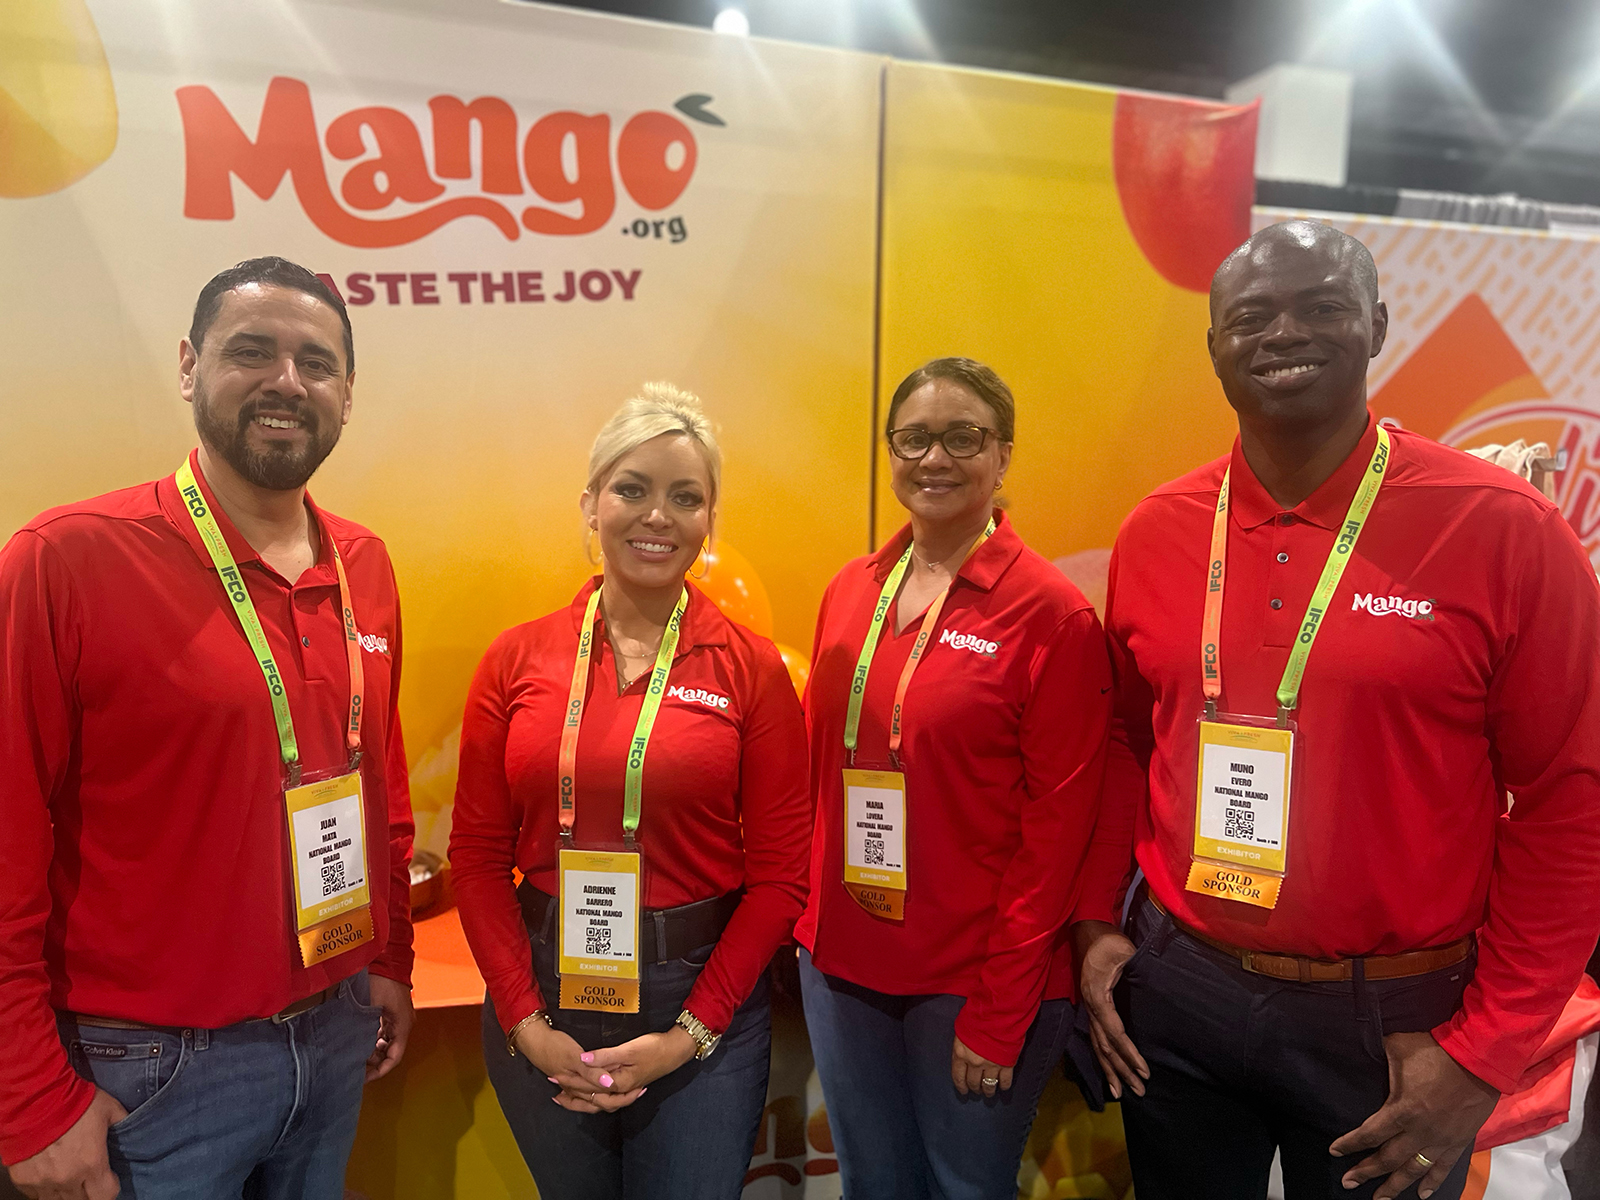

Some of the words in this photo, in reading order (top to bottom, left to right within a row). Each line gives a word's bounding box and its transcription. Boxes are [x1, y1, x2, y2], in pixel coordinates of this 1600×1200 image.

[175, 76, 697, 249] Mango
[621, 216, 687, 243] .org
[315, 272, 440, 307] STE
[448, 271, 543, 305] THE
[554, 270, 643, 304] JOY
[1372, 442, 1388, 474] IFCO
[183, 485, 206, 518] IFCO
[1336, 520, 1360, 554] IFCO
[221, 566, 246, 603] IFCO
[1210, 560, 1222, 592] IFCO
[874, 596, 890, 622] IFCO
[1351, 592, 1432, 618] Mango
[344, 607, 357, 642] IFCO
[1300, 607, 1320, 644] IFCO
[580, 631, 590, 658] IFCO
[911, 631, 928, 660] IFCO
[939, 628, 998, 654] Mango
[1205, 643, 1216, 679] IFCO
[262, 658, 282, 696] IFCO
[650, 667, 666, 694] IFCO
[853, 664, 868, 694] IFCO
[666, 686, 728, 708] Mango
[351, 694, 362, 732] IFCO
[567, 700, 581, 727] IFCO
[892, 703, 900, 736] IFCO
[630, 736, 646, 770] IFCO
[1230, 762, 1254, 774] MUNO
[562, 776, 572, 810] IFCO
[1214, 786, 1243, 798] NATIONAL
[1244, 790, 1268, 801] MANGO
[1230, 777, 1252, 787] EVERO
[866, 800, 884, 810] MARIA
[1230, 799, 1252, 809] BOARD
[320, 816, 336, 830] JUAN
[308, 845, 333, 859] NATIONAL
[334, 838, 352, 851] MANGO
[322, 831, 337, 843] MATA
[322, 852, 340, 865] BOARD
[1217, 846, 1262, 860] EXHIBITOR
[583, 884, 616, 896] ADRIENNE
[860, 872, 890, 882] EXHIBITOR
[1202, 878, 1261, 899] SPONSOR
[1216, 870, 1252, 886] GOLD
[318, 897, 354, 917] EXHIBITOR
[586, 898, 613, 907] BARRERO
[860, 890, 886, 902] GOLD
[576, 908, 602, 917] NATIONAL
[602, 910, 622, 918] MANGO
[590, 918, 608, 926] BOARD
[316, 928, 364, 957] SPONSOR
[322, 922, 353, 942] GOLD
[579, 962, 618, 972] EXHIBITOR
[574, 994, 626, 1007] SPONSOR
[584, 985, 616, 996] GOLD
